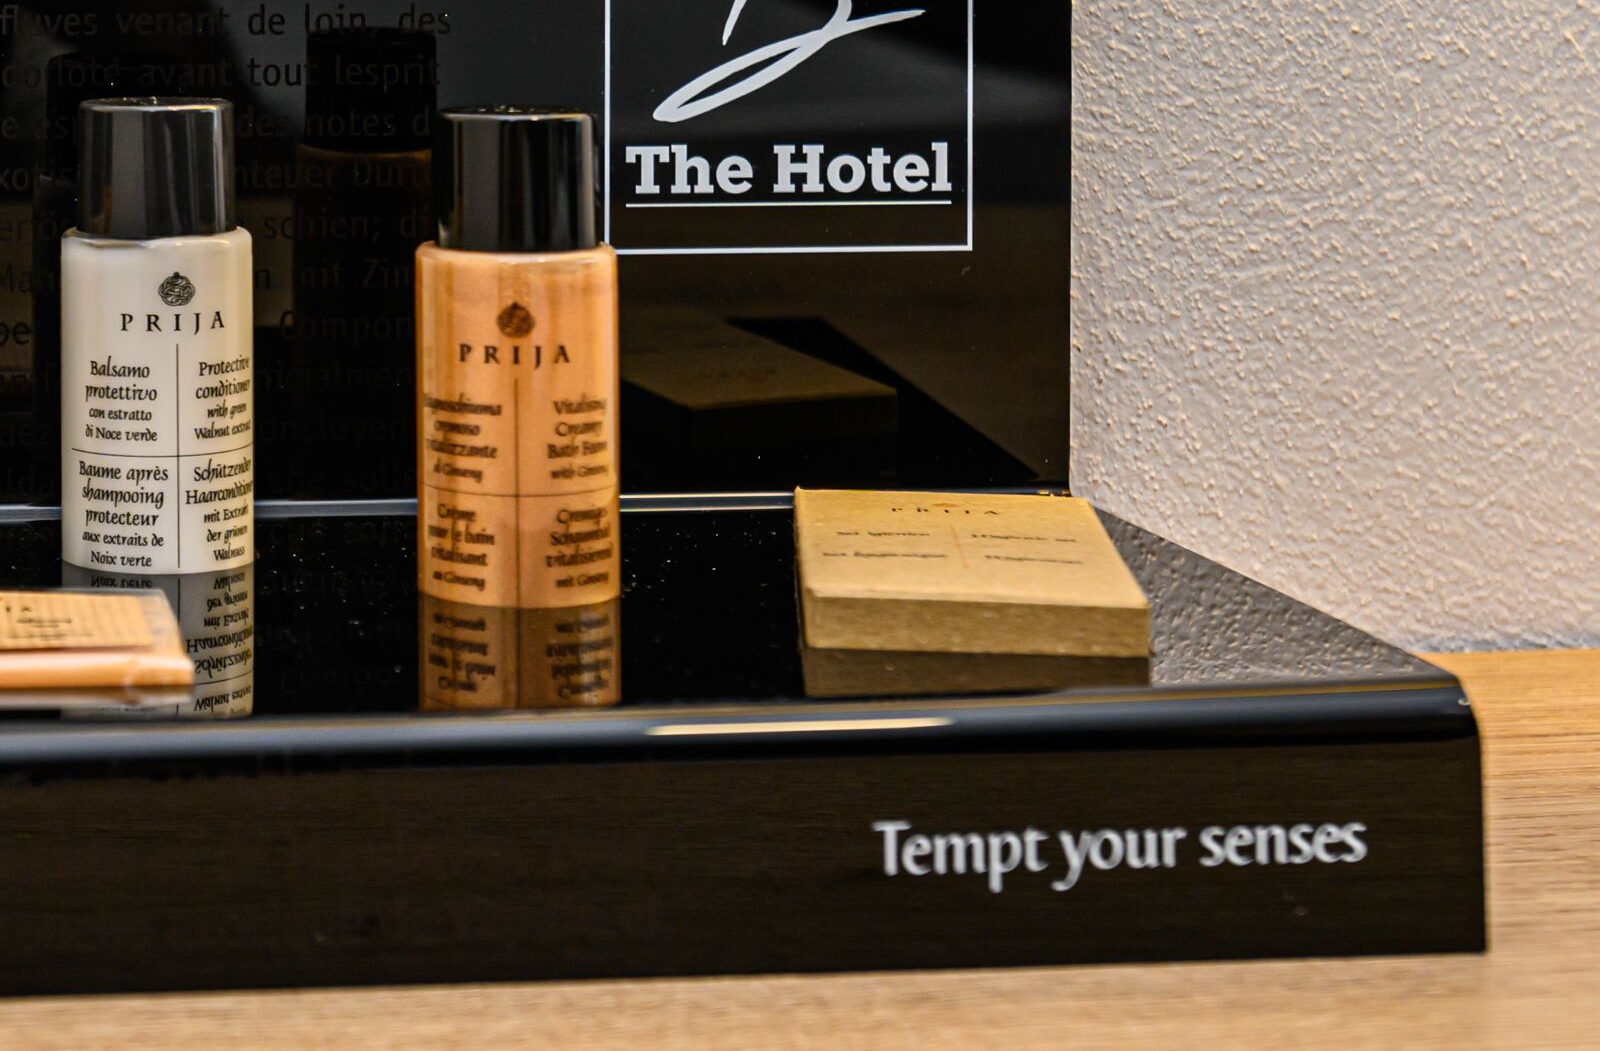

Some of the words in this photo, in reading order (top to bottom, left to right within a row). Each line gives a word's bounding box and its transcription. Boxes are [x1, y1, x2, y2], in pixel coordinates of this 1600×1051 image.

[115, 6, 230, 36] venant
[248, 4, 286, 36] de
[137, 57, 232, 87] avant
[247, 57, 318, 88] tout
[334, 53, 441, 93] lesprit
[305, 108, 399, 137] notes
[625, 144, 754, 195] The
[772, 141, 953, 195] Hotel
[120, 310, 225, 336] PRIJA
[89, 355, 150, 379] Balsamo
[458, 343, 570, 370] PRIJA
[84, 383, 158, 403] protettivo
[88, 406, 106, 419] con
[107, 408, 153, 422] estratto
[206, 399, 229, 419] with
[84, 423, 94, 438] di
[95, 426, 122, 441] Noce
[125, 427, 158, 442] verde
[193, 420, 230, 440] Walnut
[78, 460, 122, 481] Baume
[125, 466, 169, 486] après
[81, 477, 165, 510] shampooing
[84, 508, 160, 527] protecteur
[203, 508, 221, 524] mit
[82, 531, 101, 543] aux
[102, 532, 149, 547] extraits
[150, 533, 165, 547] de
[206, 528, 222, 543] der
[90, 550, 117, 566] Noix
[120, 555, 153, 568] verte
[871, 820, 1049, 894] Tempt
[1050, 826, 1188, 892] your
[1199, 821, 1368, 867] senses
